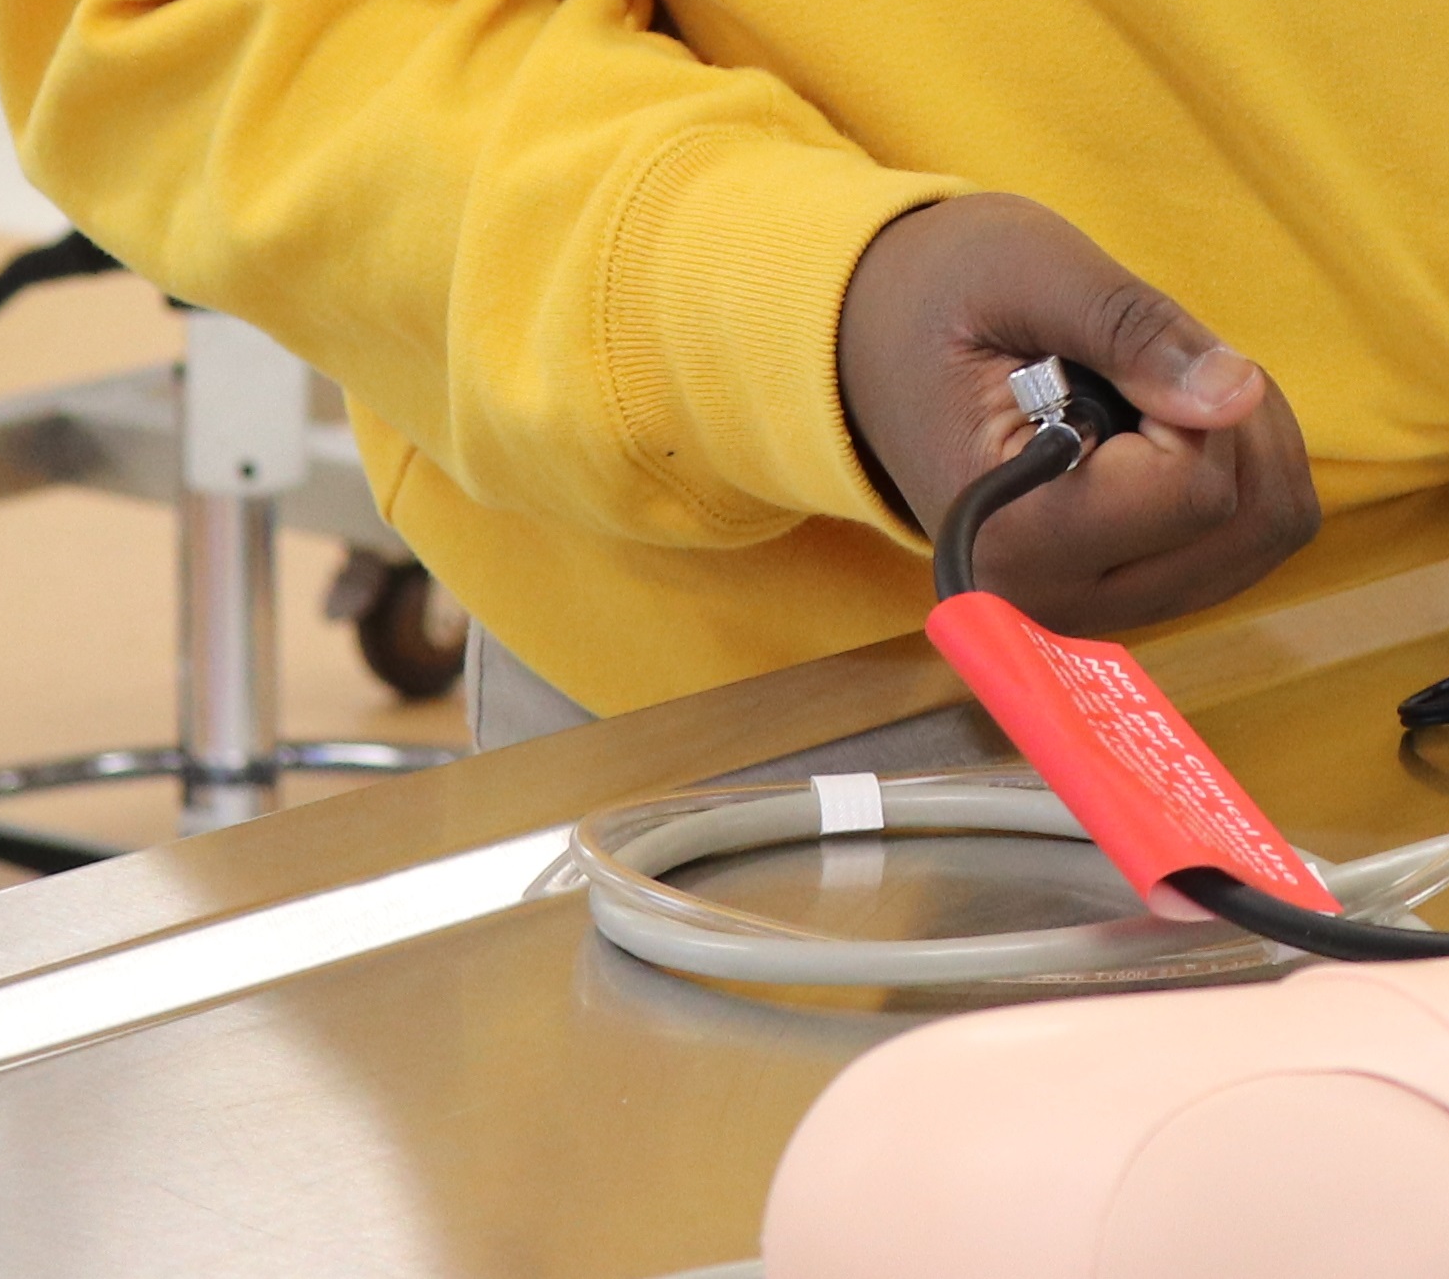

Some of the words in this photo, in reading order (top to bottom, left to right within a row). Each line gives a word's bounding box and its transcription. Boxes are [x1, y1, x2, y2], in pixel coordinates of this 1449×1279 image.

[1084, 657, 1125, 700] Non
[1126, 712, 1167, 750] per
[1172, 762, 1207, 798] uso
[1104, 660, 1148, 704] Not
[1145, 710, 1185, 749] For
[1184, 754, 1262, 837] Clinical
[1258, 843, 1299, 885] Use
